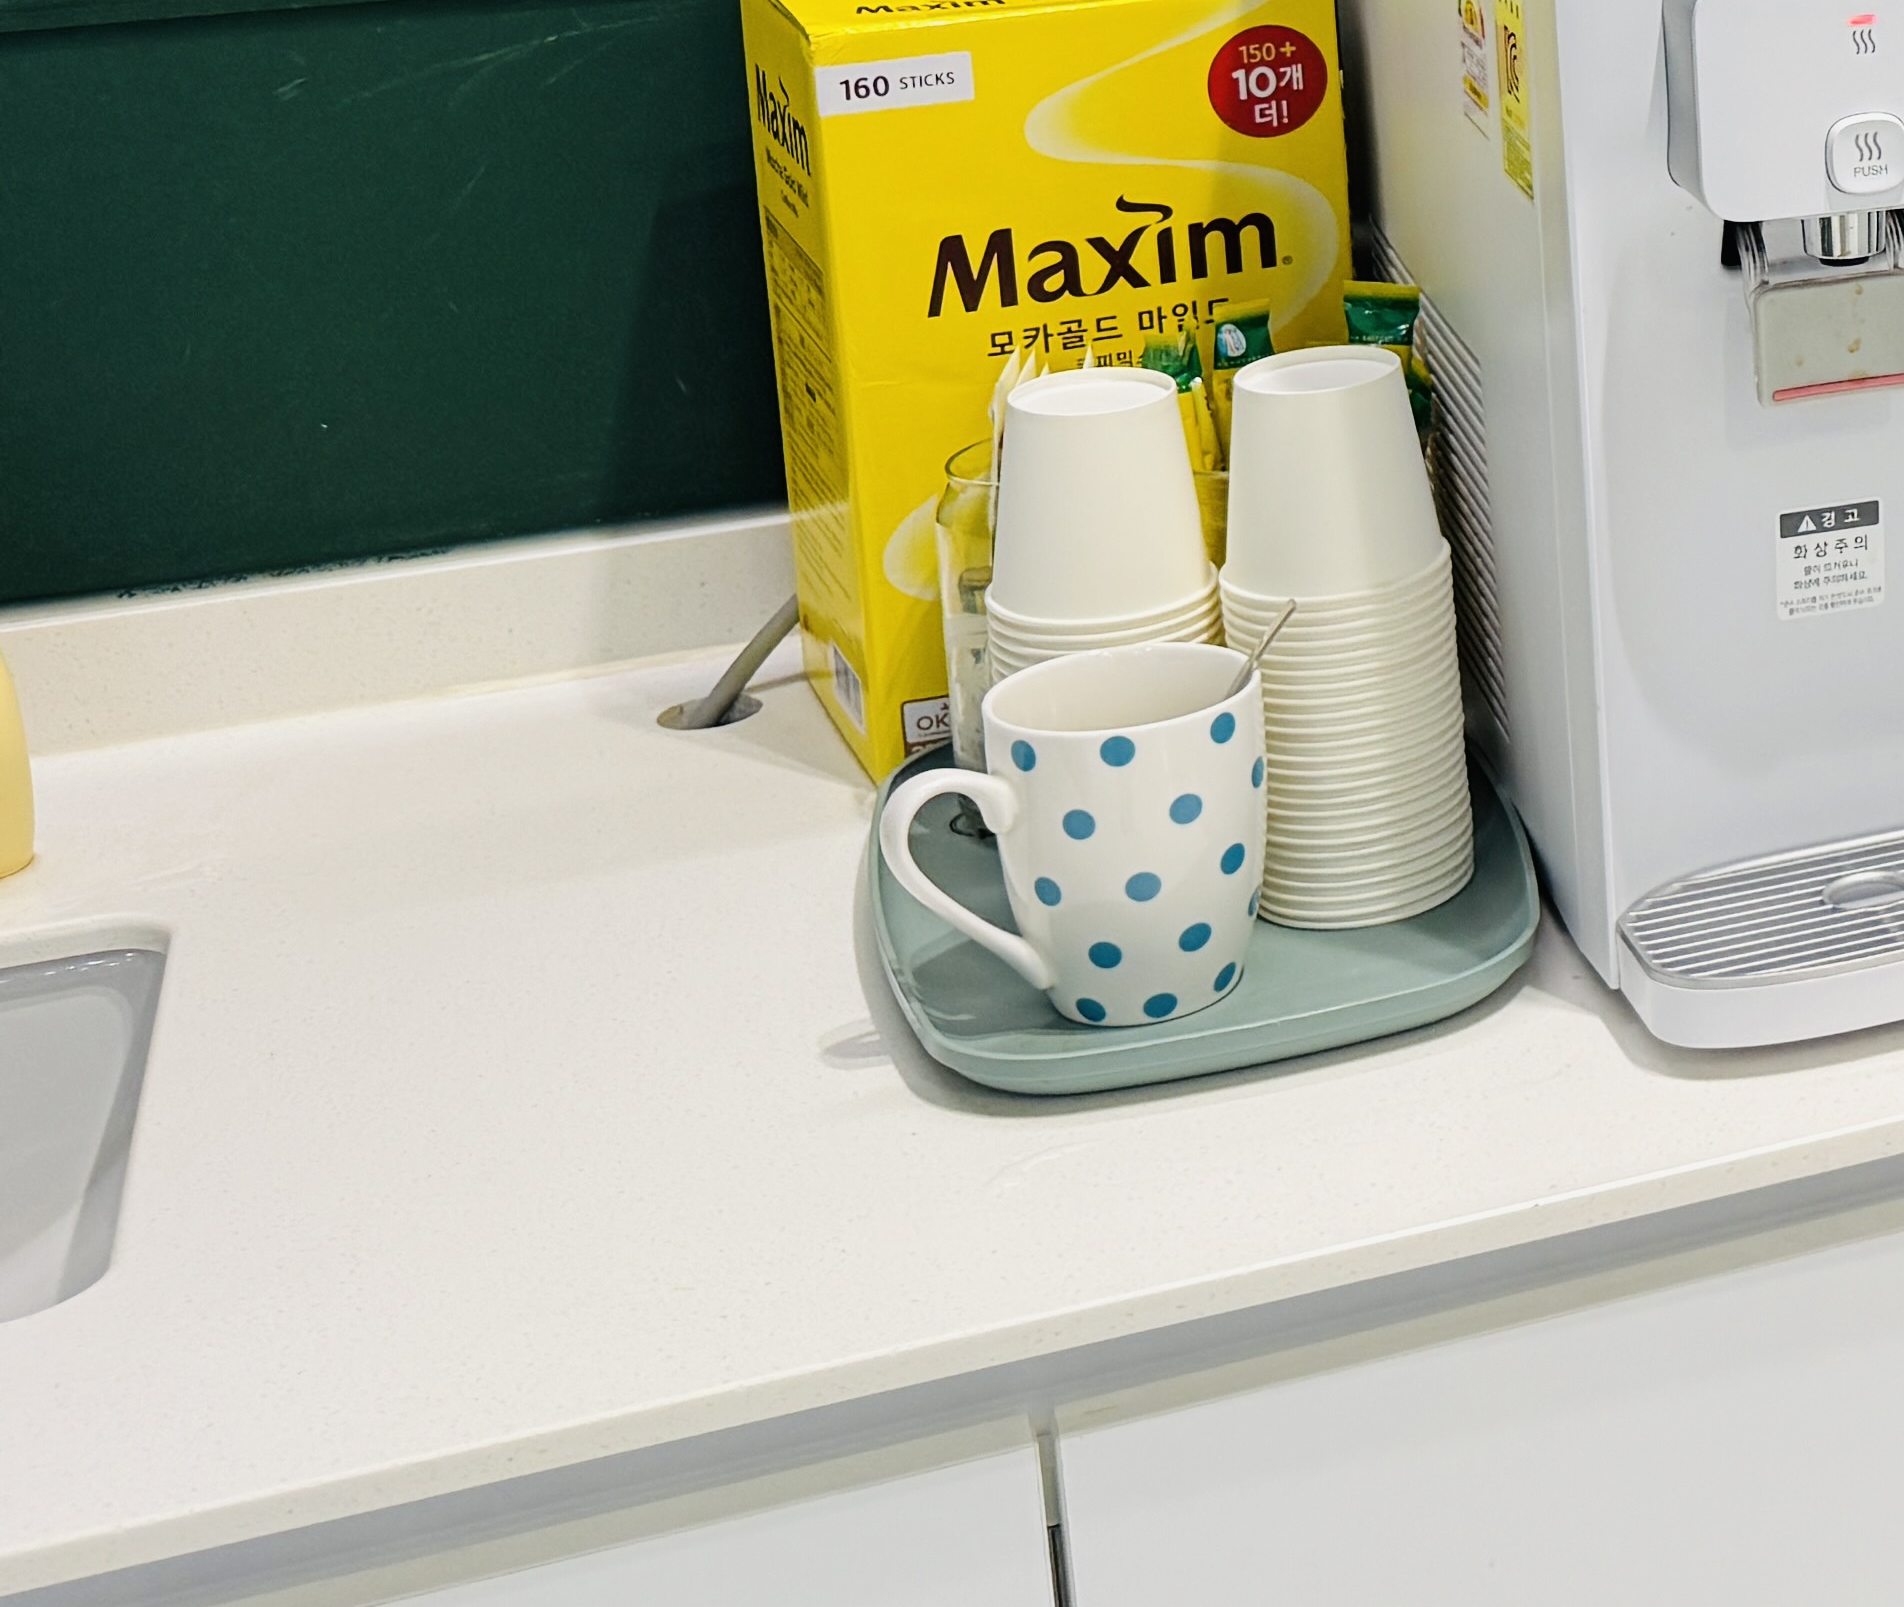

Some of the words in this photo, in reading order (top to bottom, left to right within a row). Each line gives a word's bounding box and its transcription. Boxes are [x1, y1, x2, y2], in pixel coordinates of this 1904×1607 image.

[839, 75, 890, 101] 160
[899, 71, 955, 90] STICKS
[1231, 63, 1304, 101] 10개
[754, 63, 812, 178] Maxim
[1254, 100, 1289, 127] 더!
[1853, 163, 1889, 178] PUSH
[926, 193, 1278, 319] Maxim
[986, 314, 1124, 359] 모카골드
[1821, 508, 1861, 528] 경고
